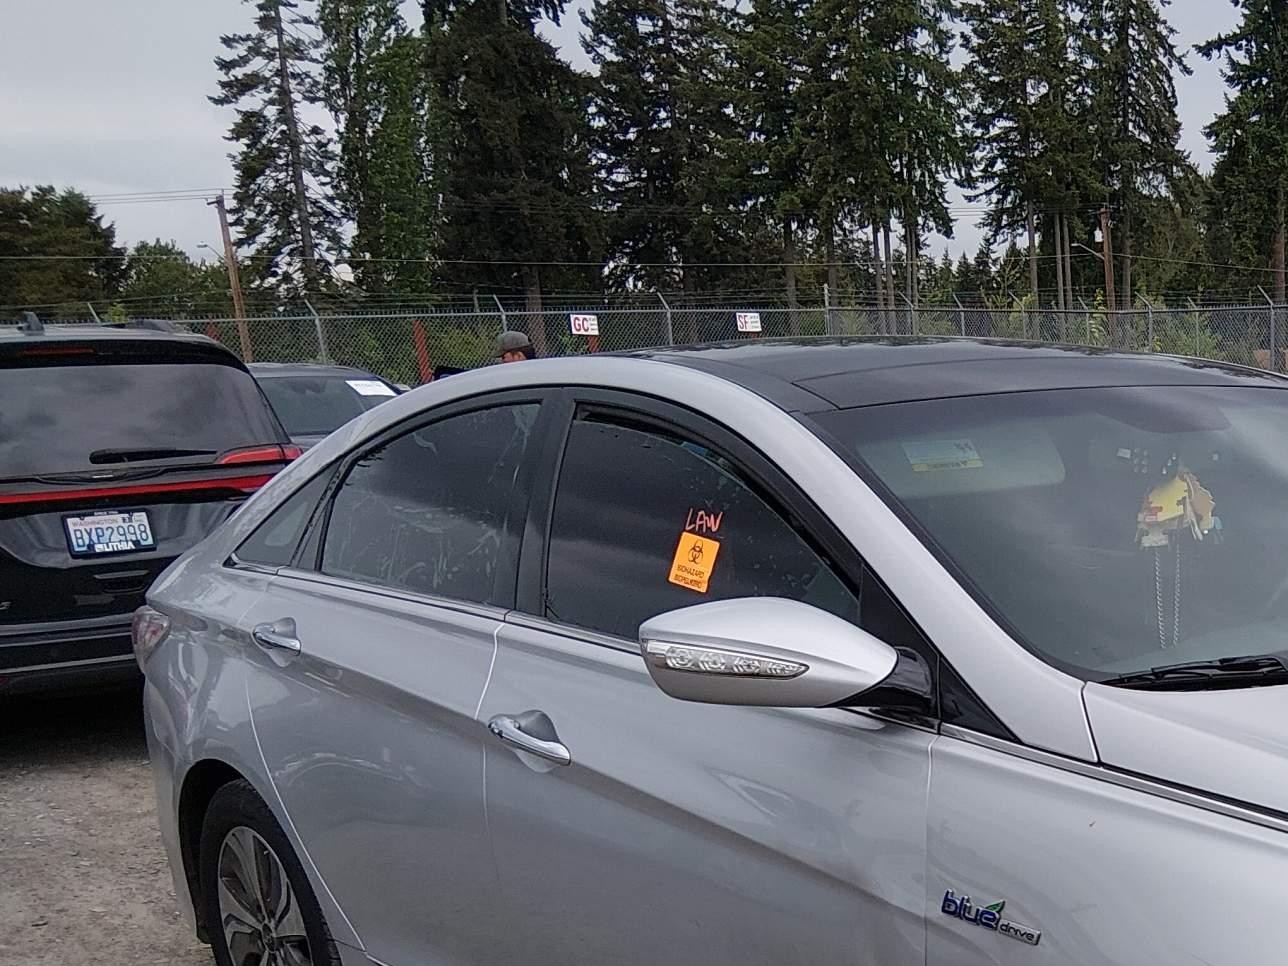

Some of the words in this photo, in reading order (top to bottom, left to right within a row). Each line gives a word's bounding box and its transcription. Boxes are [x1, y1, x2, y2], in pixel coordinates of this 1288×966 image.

[573, 316, 589, 332] GC
[738, 314, 748, 330] SF
[72, 518, 118, 527] WASHINGTON
[685, 507, 723, 533] LAW
[74, 523, 149, 547] BXP2998
[941, 888, 1000, 931] blue
[1000, 922, 1035, 942] drive
